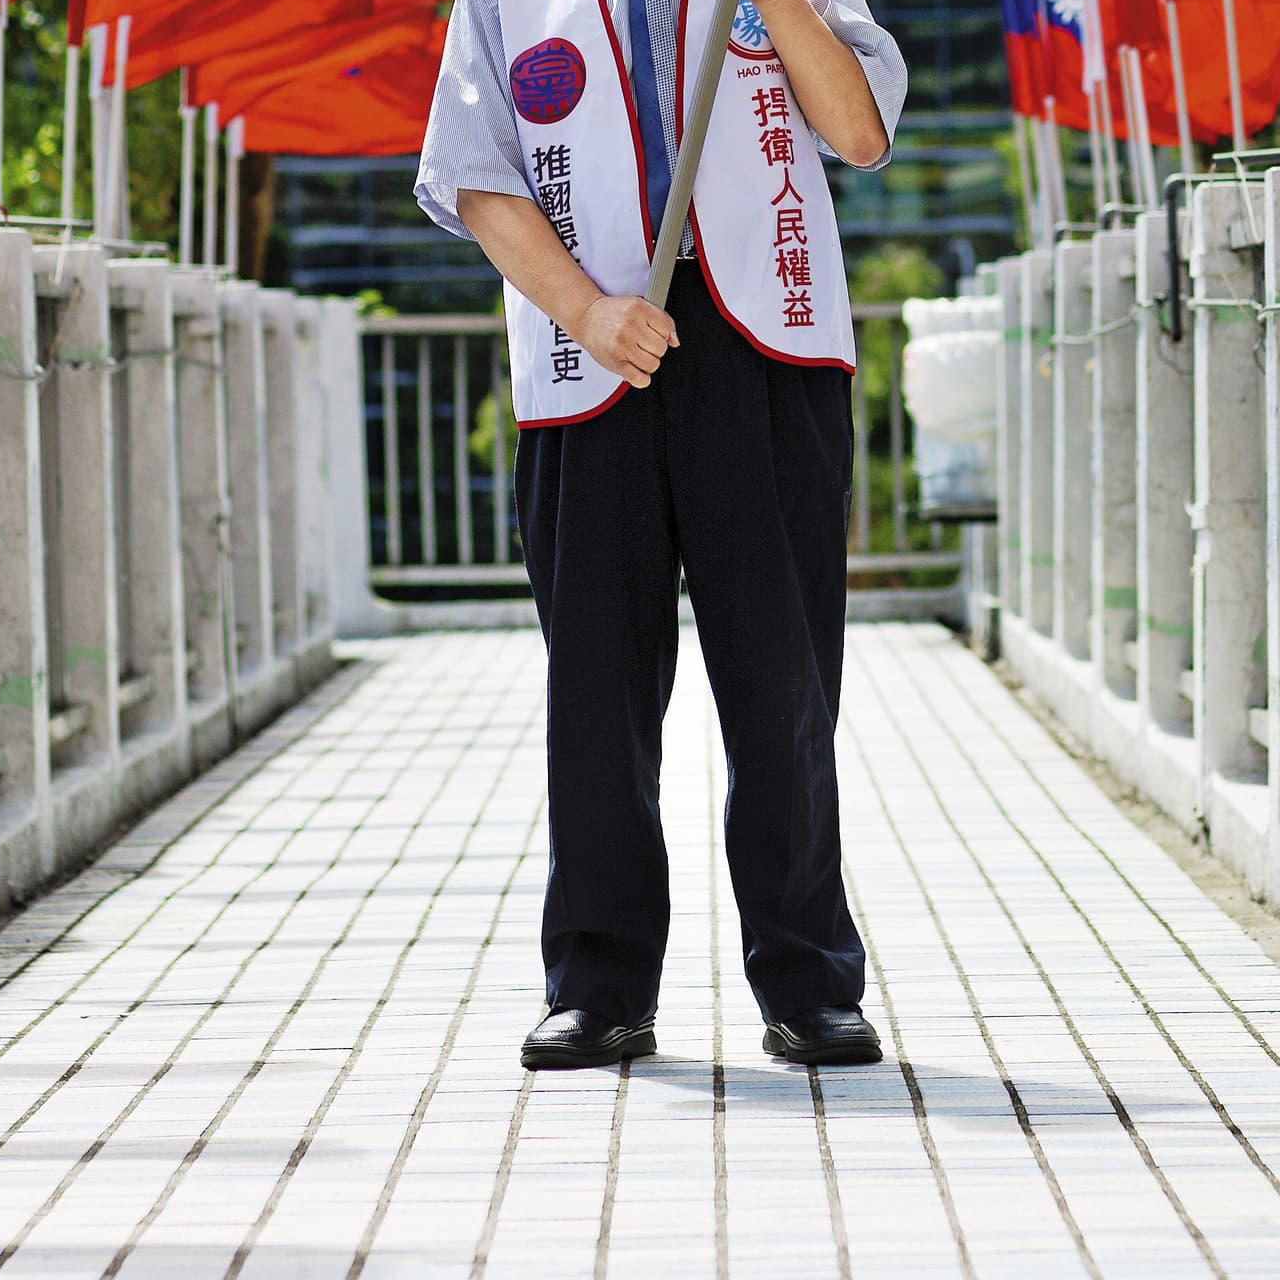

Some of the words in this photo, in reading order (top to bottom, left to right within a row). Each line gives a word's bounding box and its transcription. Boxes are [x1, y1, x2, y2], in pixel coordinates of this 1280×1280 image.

[736, 65, 761, 79] HAO
[751, 86, 815, 328] 捍衛人民權益
